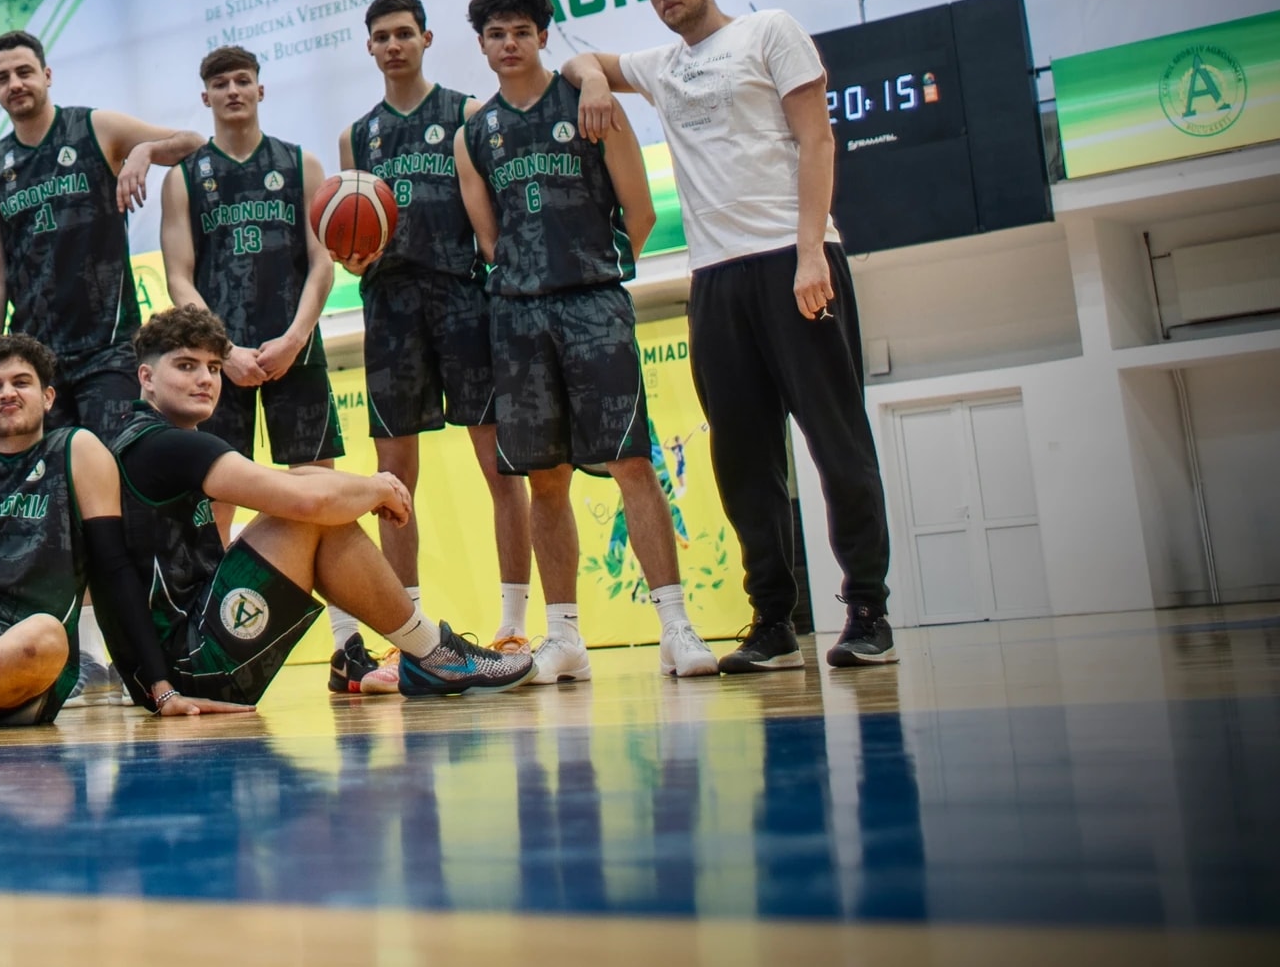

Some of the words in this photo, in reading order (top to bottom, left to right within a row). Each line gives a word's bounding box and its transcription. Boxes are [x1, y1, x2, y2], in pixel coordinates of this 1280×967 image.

[393, 179, 412, 208] 8
[525, 181, 542, 214] 6
[233, 225, 262, 255] 13
